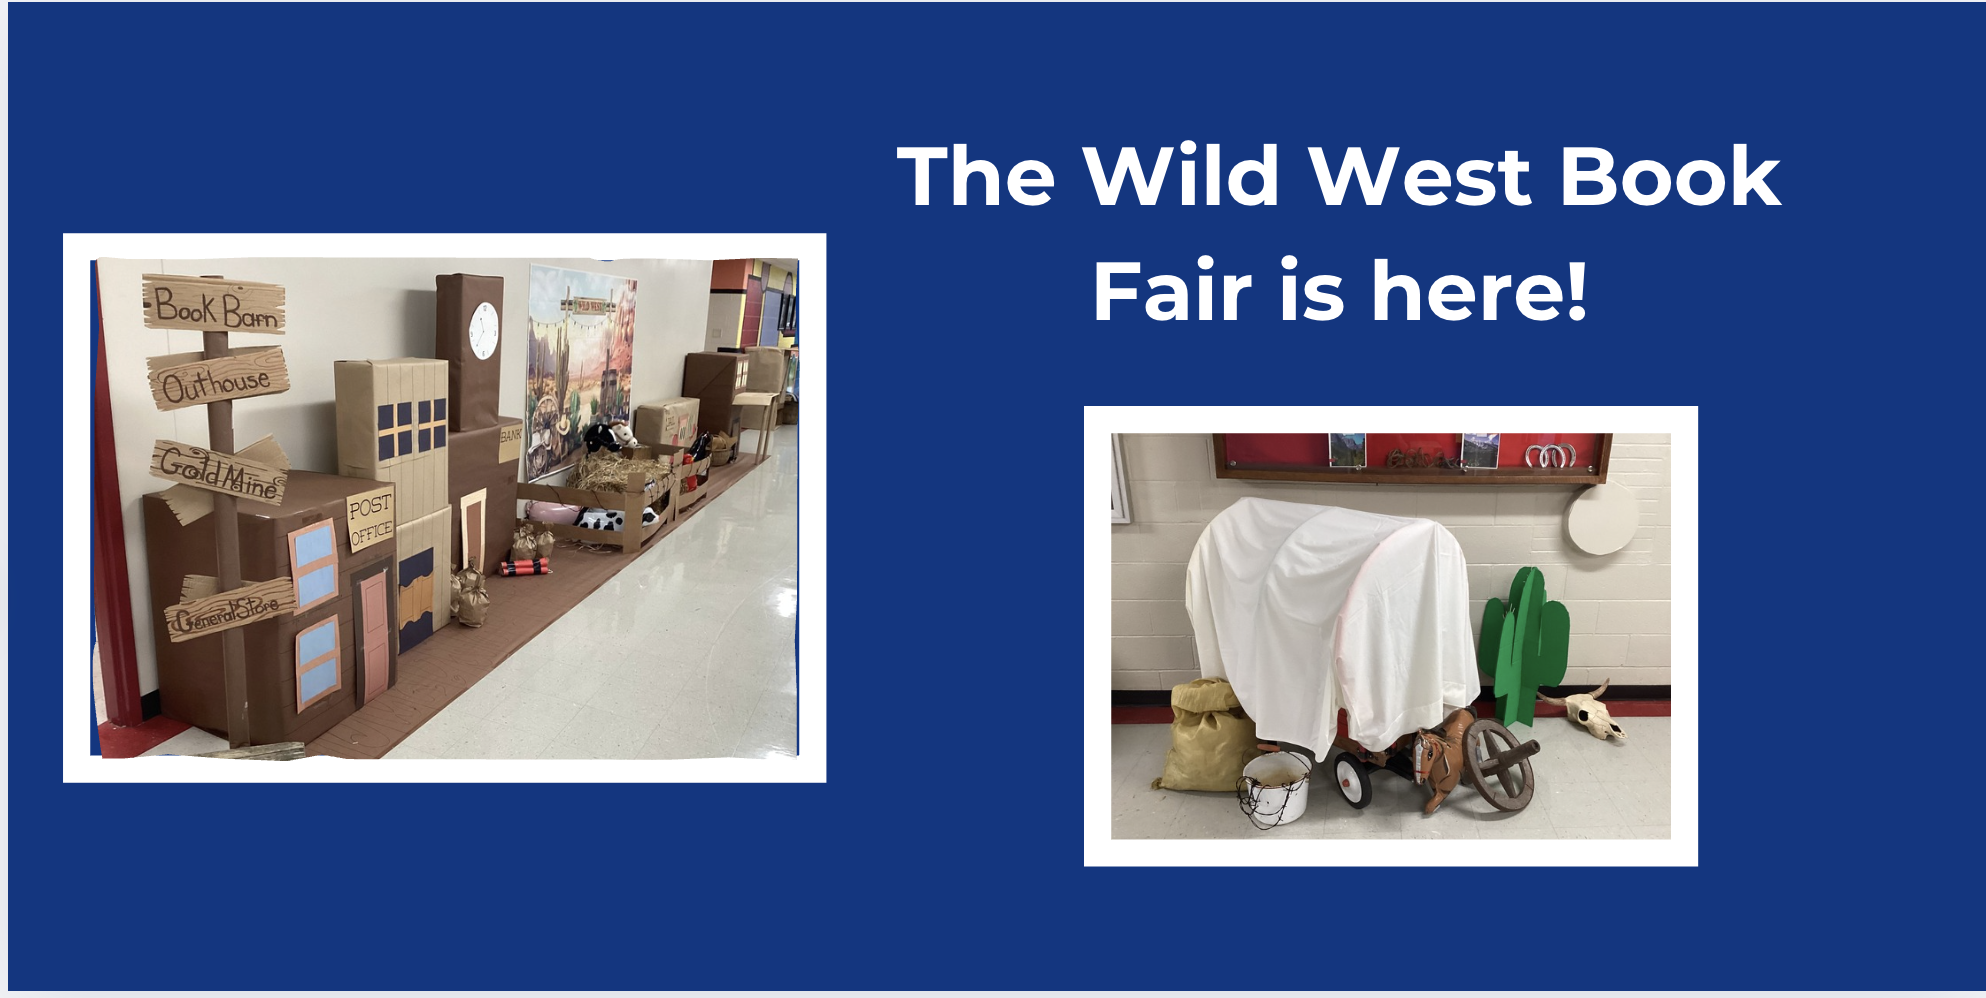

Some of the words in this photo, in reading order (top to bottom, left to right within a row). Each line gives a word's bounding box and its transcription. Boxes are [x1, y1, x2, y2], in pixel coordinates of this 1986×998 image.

[155, 286, 217, 323] Book
[223, 293, 278, 328] Barn
[163, 370, 270, 403] Outhouse
[500, 428, 522, 443] BANK
[161, 447, 221, 486] Gold
[222, 464, 277, 499] Mine
[350, 493, 392, 520] POST
[351, 520, 393, 546] OFFICE
[176, 600, 236, 633] General
[236, 597, 280, 619] Store
